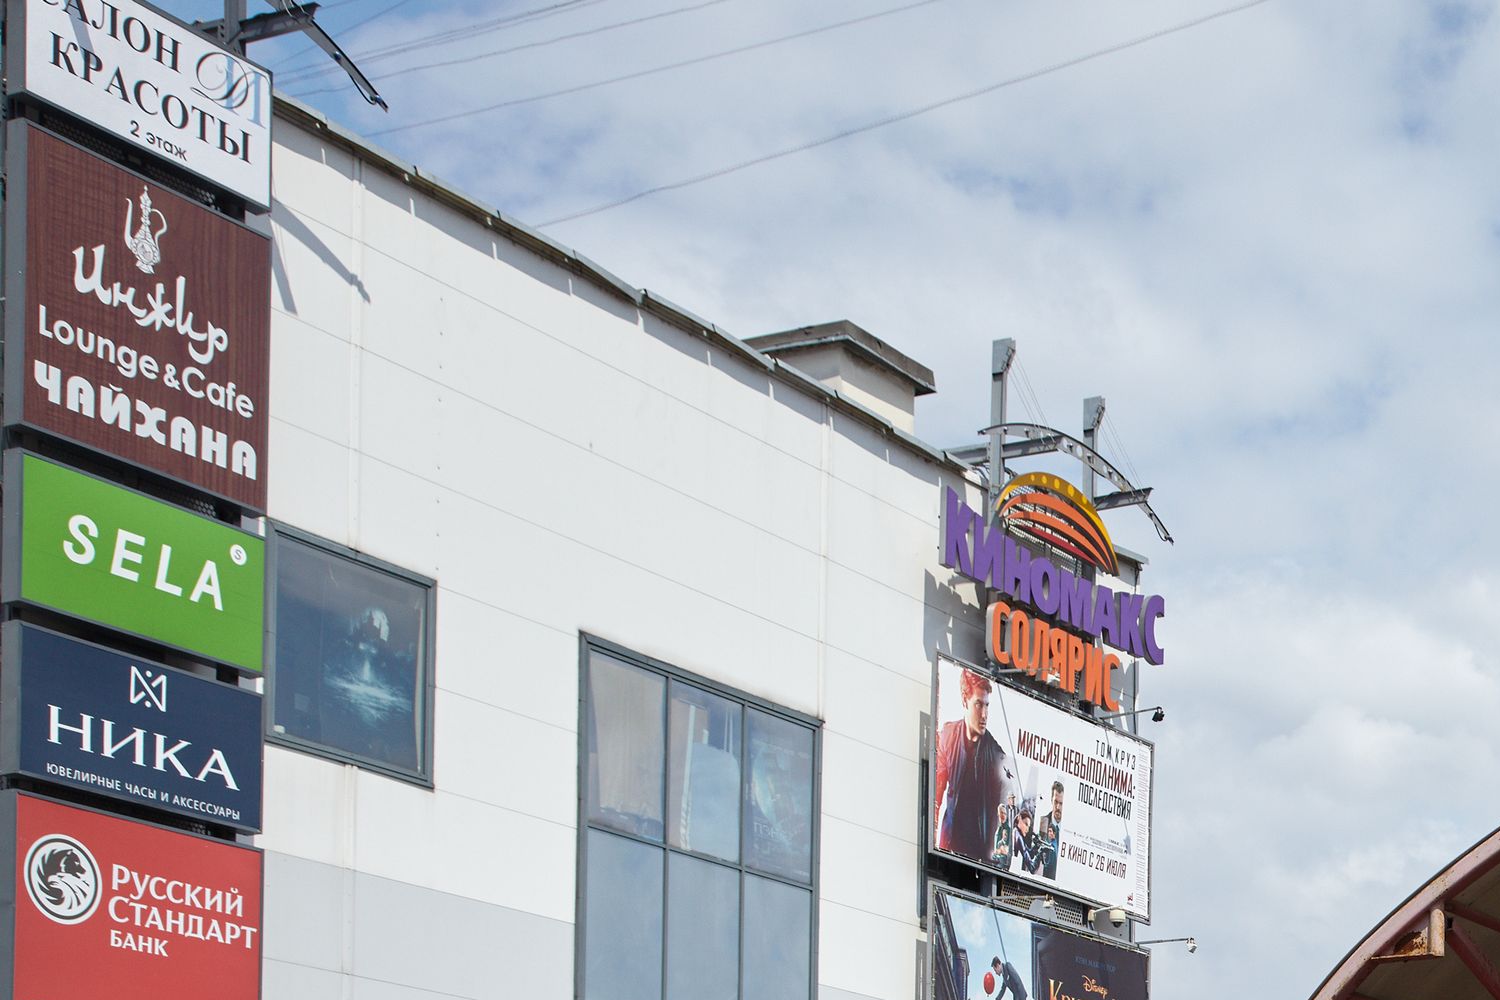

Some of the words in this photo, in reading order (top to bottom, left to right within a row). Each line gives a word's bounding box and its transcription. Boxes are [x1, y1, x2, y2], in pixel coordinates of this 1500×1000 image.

[43, 0, 183, 74] АЛОН
[48, 31, 253, 165] КРАСОТЫ
[130, 119, 140, 138] 2
[145, 131, 188, 162] этаж
[34, 359, 257, 480] ЧАЙХАНА
[63, 514, 224, 611] SELA
[941, 485, 1166, 666] КИНОМАКС
[986, 601, 1120, 713] СОЛЯРИС
[47, 703, 241, 792] НИКА
[1017, 728, 1061, 769] МИССИЯ
[1061, 746, 1136, 800] НЕВЫПОЛНИМА:
[1095, 739, 1113, 760] ТОМ
[1115, 748, 1136, 770] КРУЗ
[46, 762, 121, 791] ЮВЕЛИРНЫЕ
[124, 782, 157, 799] ЧАСЫ
[160, 791, 169, 803] И
[172, 794, 241, 821] АКСЕССУАРЫ
[1078, 782, 1132, 821] ПОСЛЕДСТВИЯ
[111, 863, 244, 918] РУССКИЙ
[1060, 842, 1067, 858] В
[1067, 844, 1088, 866] КИНО
[1089, 852, 1094, 868] С
[1095, 854, 1105, 872] 26
[1106, 858, 1127, 880] ИЮЛЯ
[108, 895, 258, 950] СТАНДАРТ
[109, 929, 169, 958] БАНК
